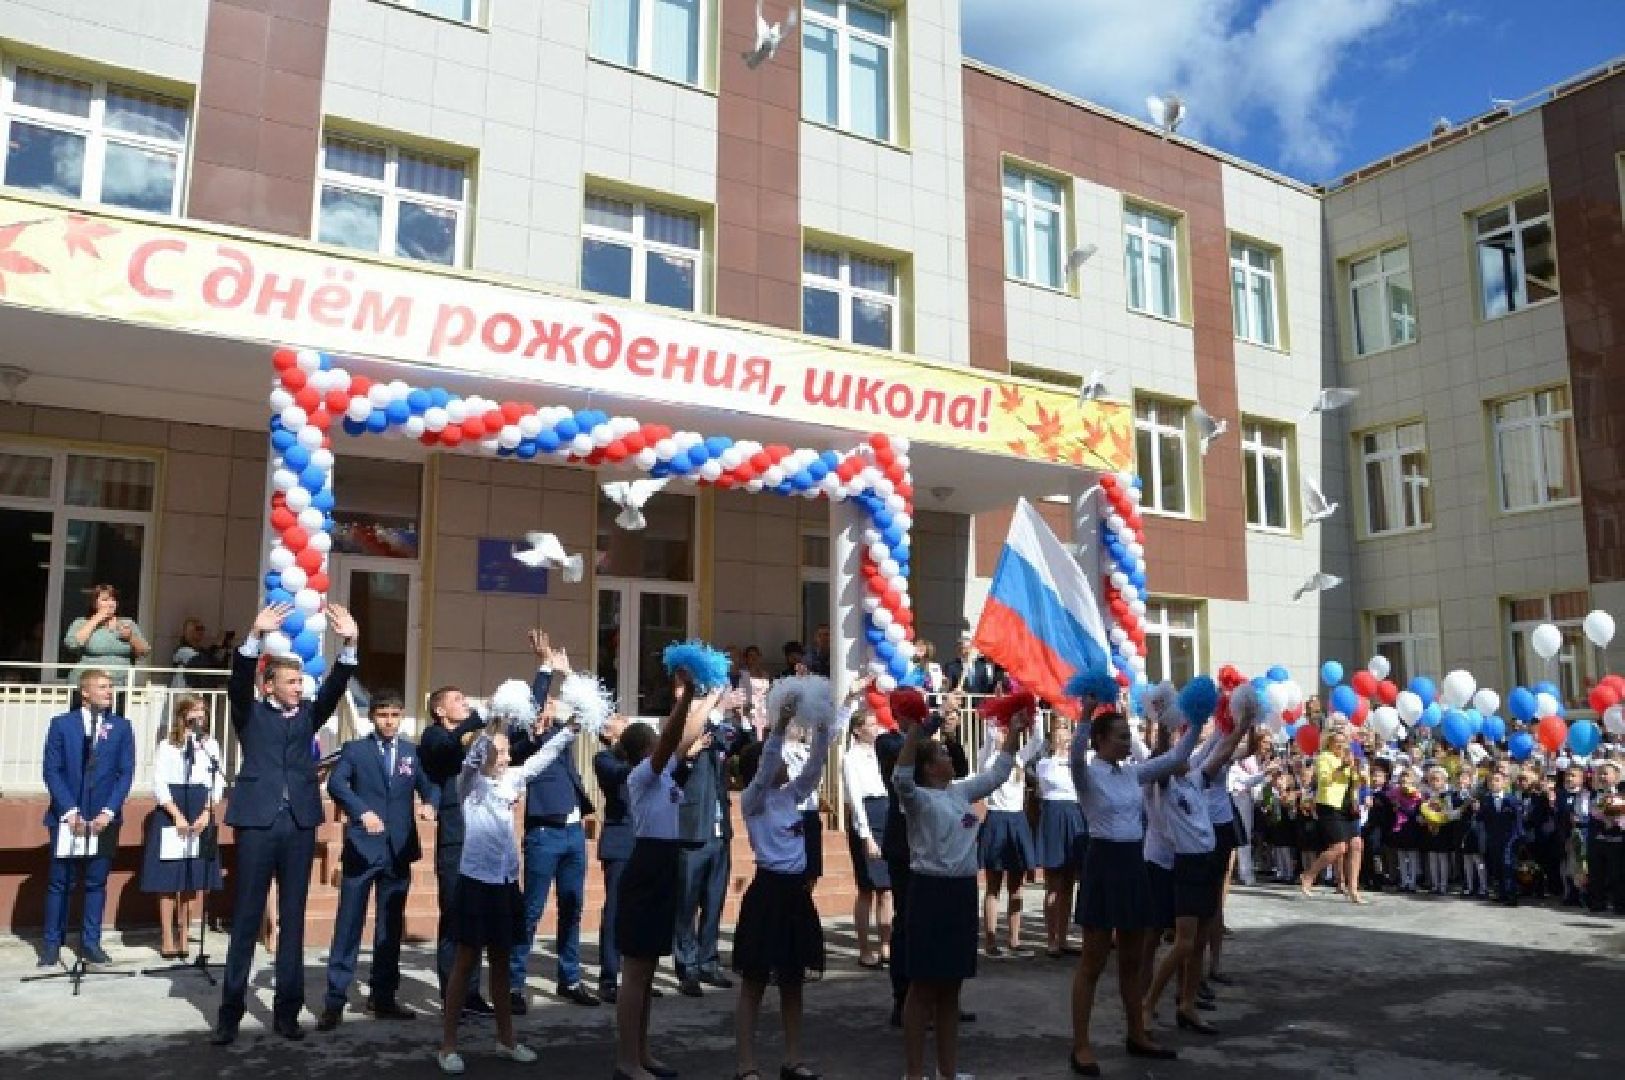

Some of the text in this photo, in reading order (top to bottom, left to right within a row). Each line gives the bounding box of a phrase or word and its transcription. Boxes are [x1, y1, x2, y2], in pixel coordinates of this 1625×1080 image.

[127, 239, 993, 433] С днём рождения, школа!
